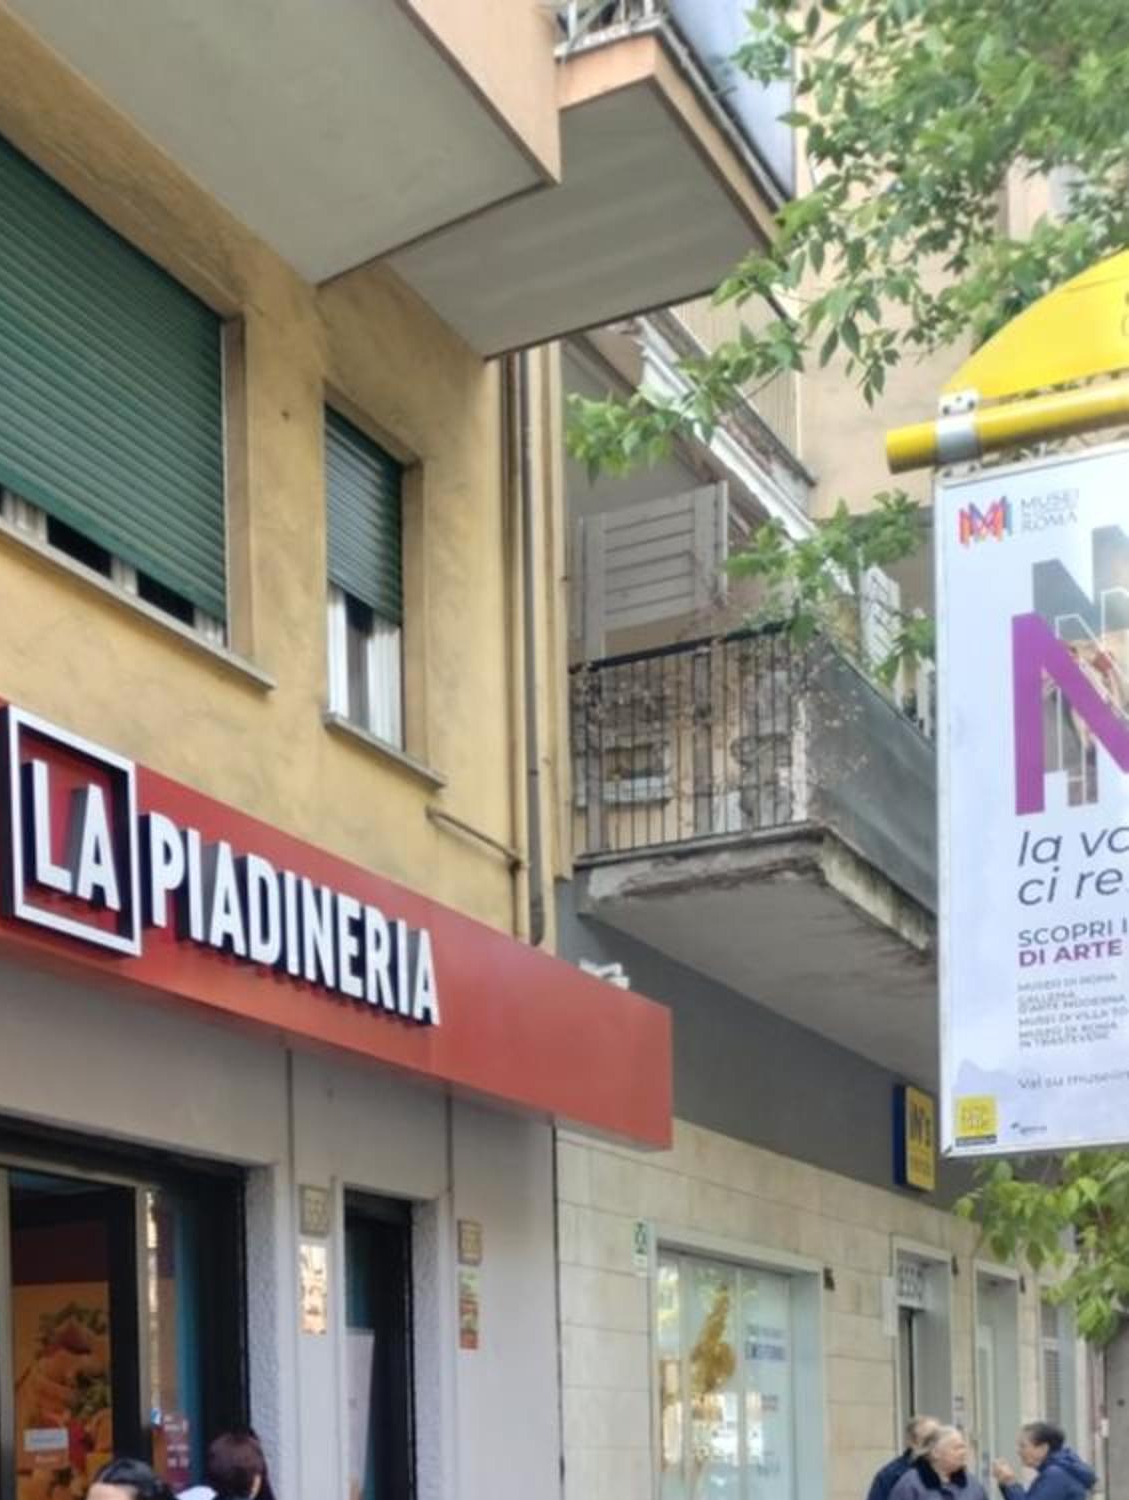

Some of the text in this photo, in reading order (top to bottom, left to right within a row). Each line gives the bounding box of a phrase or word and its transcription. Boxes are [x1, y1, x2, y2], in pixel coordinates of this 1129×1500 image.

[1022, 511, 1078, 532] ROMA
[1018, 830, 1063, 867] la
[31, 758, 440, 1025] LA PIADINERIA
[1018, 866, 1129, 906] ci re
[1018, 919, 1112, 948] SCOPRI
[1019, 938, 1123, 968] DI ARTE
